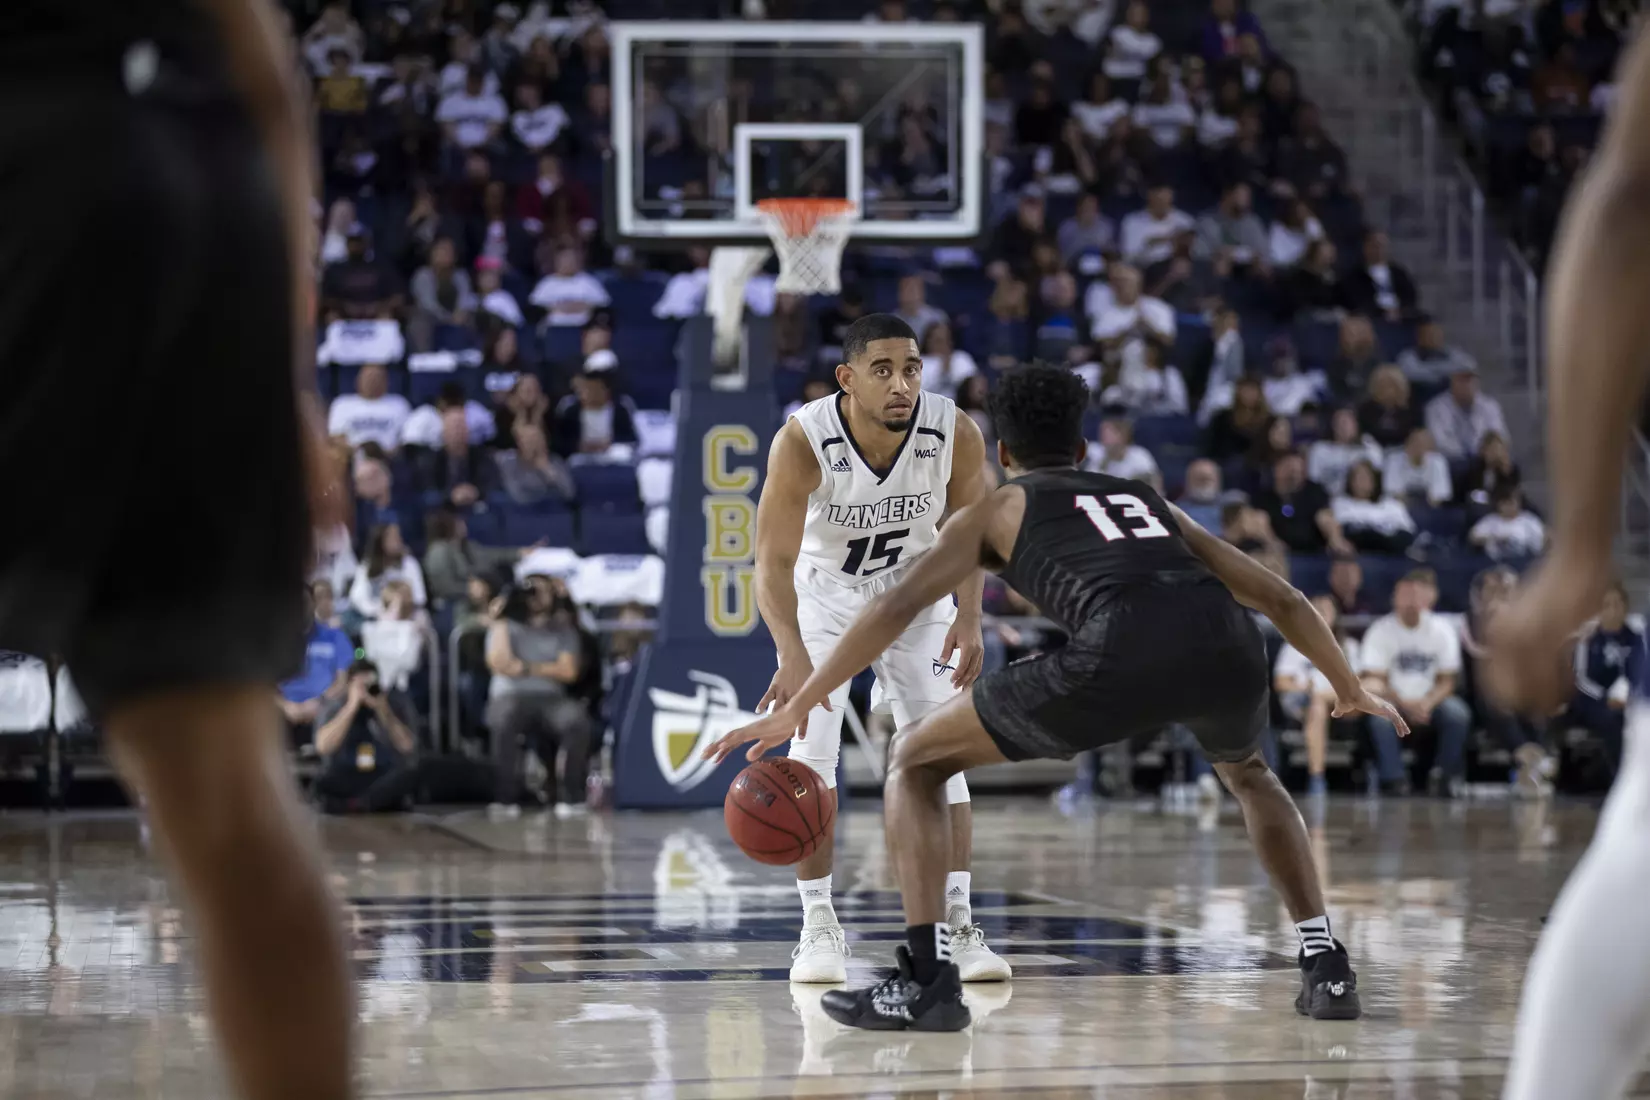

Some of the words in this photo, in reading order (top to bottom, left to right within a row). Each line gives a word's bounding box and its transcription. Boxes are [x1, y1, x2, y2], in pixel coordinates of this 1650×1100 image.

[915, 448, 937, 459] WAC
[702, 424, 759, 637] CBU
[828, 491, 931, 529] LANCERS
[1073, 493, 1171, 542] 13
[841, 528, 910, 577] 15
